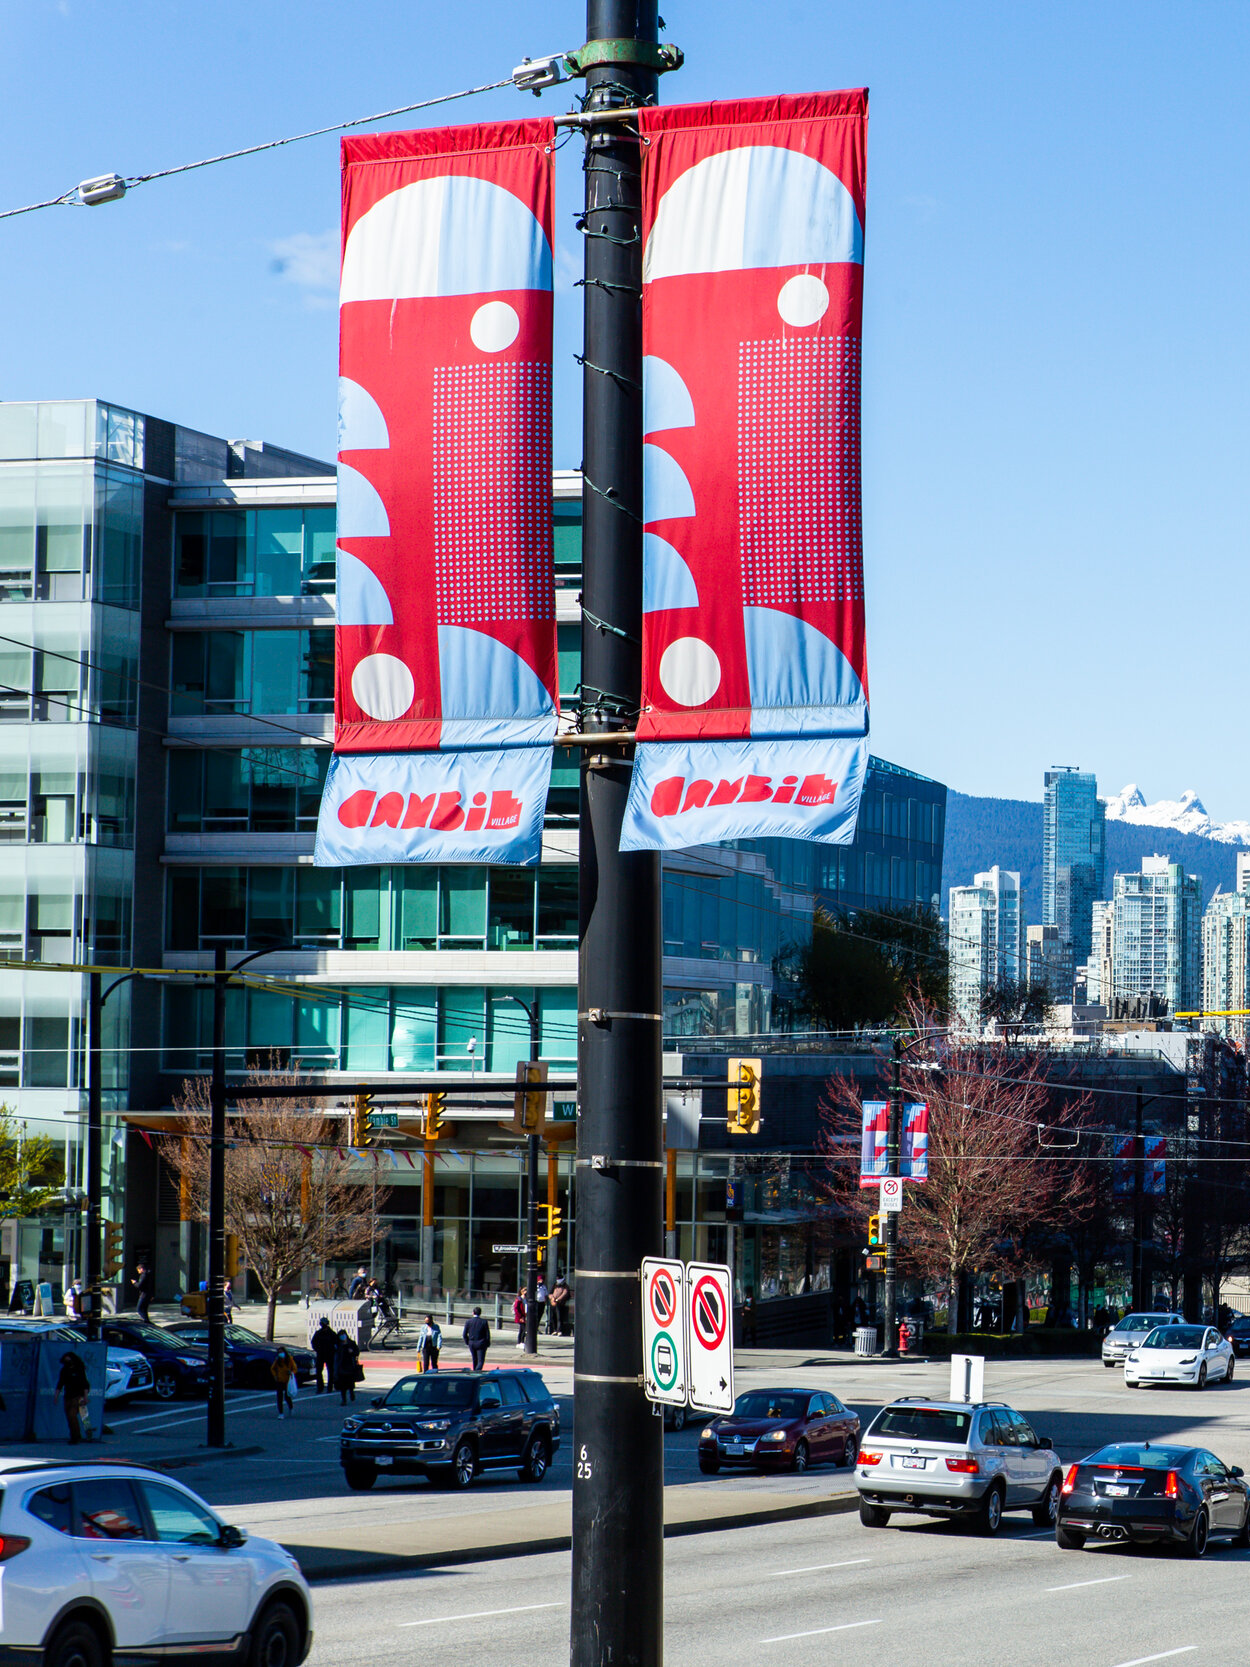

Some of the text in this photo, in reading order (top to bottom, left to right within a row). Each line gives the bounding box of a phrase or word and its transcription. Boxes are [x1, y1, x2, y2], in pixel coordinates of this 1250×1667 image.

[801, 792, 831, 803] VILLAGE
[491, 814, 518, 827] VILLAGE
[562, 1104, 575, 1116] W
[580, 1444, 588, 1460] 6
[577, 1462, 592, 1479] 25
